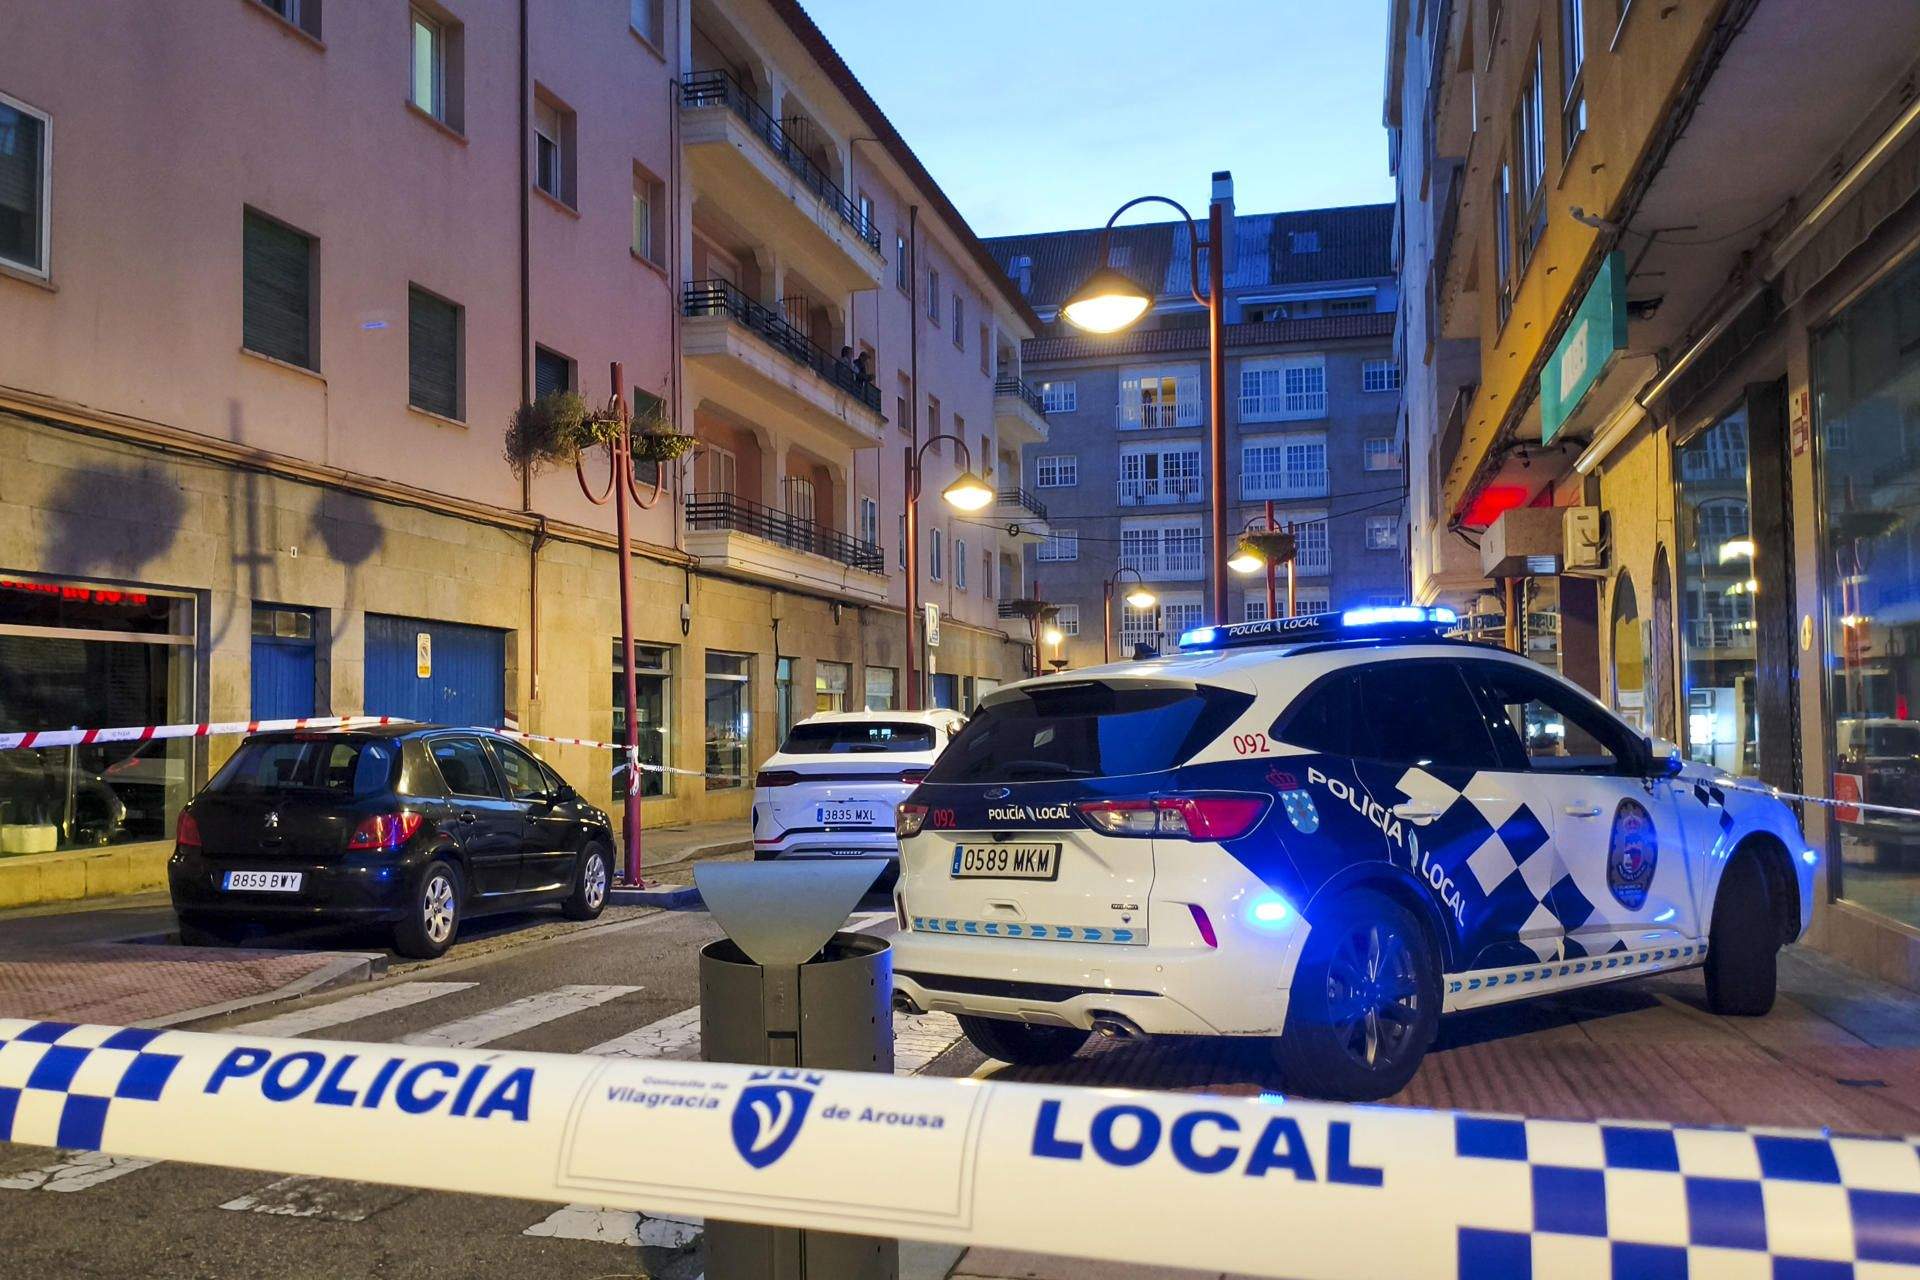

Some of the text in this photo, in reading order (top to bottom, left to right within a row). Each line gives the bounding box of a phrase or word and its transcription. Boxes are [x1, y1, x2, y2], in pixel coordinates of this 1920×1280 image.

[1283, 616, 1320, 630] LOCAL
[1233, 733, 1270, 755] 092
[824, 809, 876, 821] 3835 MXL
[933, 809, 956, 827] 092
[1036, 806, 1070, 820] LOCAL
[964, 848, 1009, 872] 0589
[1013, 848, 1050, 872] MKM
[232, 873, 298, 888] 8859 BWY
[1421, 850, 1467, 928] LOCAL
[822, 1104, 945, 1130] de Arousa
[1030, 1099, 1384, 1188] LOCAL
